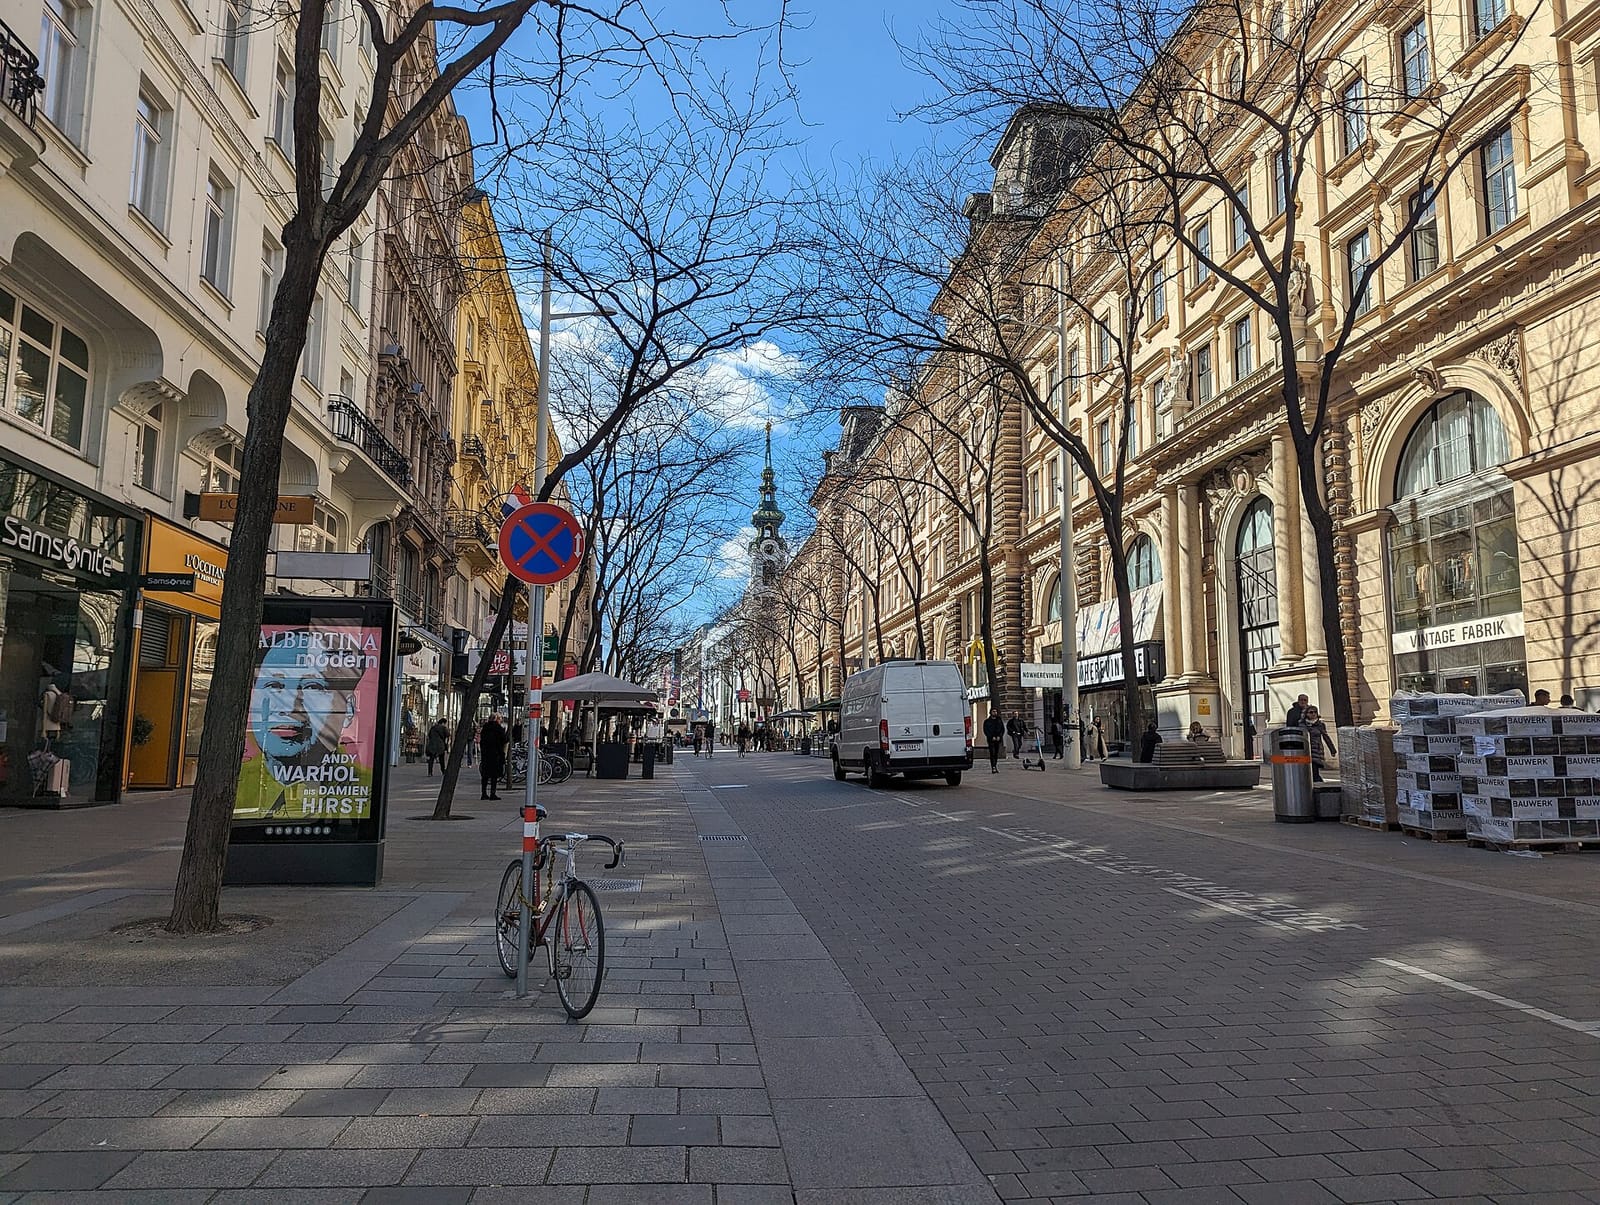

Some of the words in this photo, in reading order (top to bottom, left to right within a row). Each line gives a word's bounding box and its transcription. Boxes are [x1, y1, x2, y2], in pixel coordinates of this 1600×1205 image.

[2, 516, 114, 577] Samsonite
[186, 553, 226, 580] L'OCCITAN
[147, 577, 192, 586] Samsonite
[258, 630, 378, 651] ALBERTINA
[1410, 628, 1455, 648] VINTAGE
[1462, 620, 1505, 641] FABRIK
[295, 650, 378, 669] modern
[321, 754, 358, 764] ANDY
[1508, 758, 1548, 766] BAUWERK
[273, 765, 360, 782] WARHOL
[319, 785, 368, 796] DAMIEN
[302, 797, 368, 814] HIRST
[1576, 799, 1600, 807] BAUW
[1432, 811, 1465, 819] BAUWER
